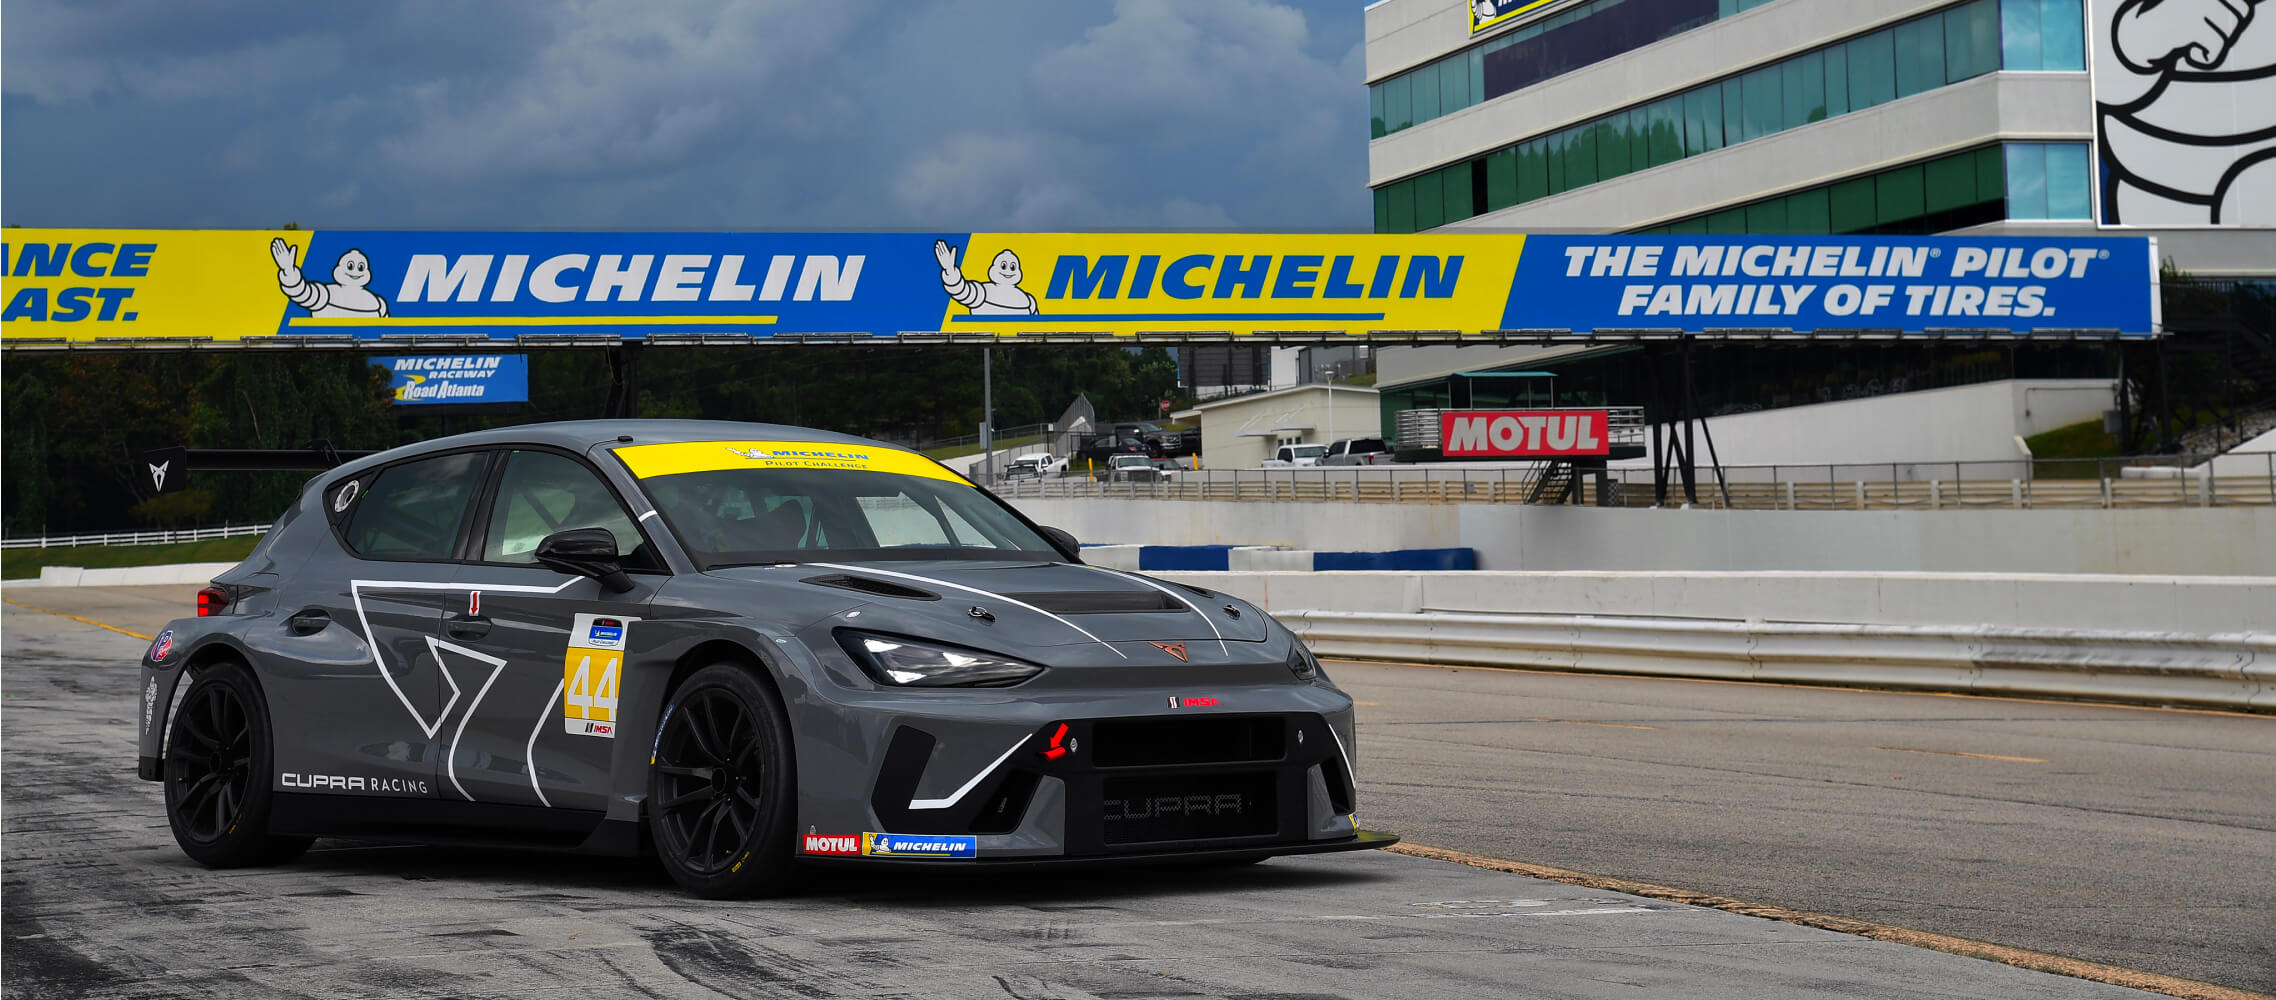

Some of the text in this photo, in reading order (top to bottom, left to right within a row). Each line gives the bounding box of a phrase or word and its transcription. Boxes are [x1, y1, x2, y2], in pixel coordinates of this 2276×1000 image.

[1, 242, 158, 278] NCE
[1565, 246, 1664, 277] THE
[396, 254, 866, 303] MICHELIN
[1044, 254, 1465, 299] MICHELIN
[1617, 284, 2056, 317] FAMILY OF TIRES.
[394, 356, 502, 371] MICHELIN
[428, 370, 496, 379] RACEWAY
[403, 380, 485, 400] Road Atlanta
[1448, 415, 1600, 452] MOTUL
[772, 450, 869, 460] MICHELIN
[567, 655, 619, 722] 44
[1183, 696, 1223, 707] IMSA
[593, 724, 613, 735] IMSA
[281, 772, 429, 794] CUPRA RACING
[1103, 793, 1242, 821] CUPRA
[805, 836, 967, 852] MOTUL MICHELIN
